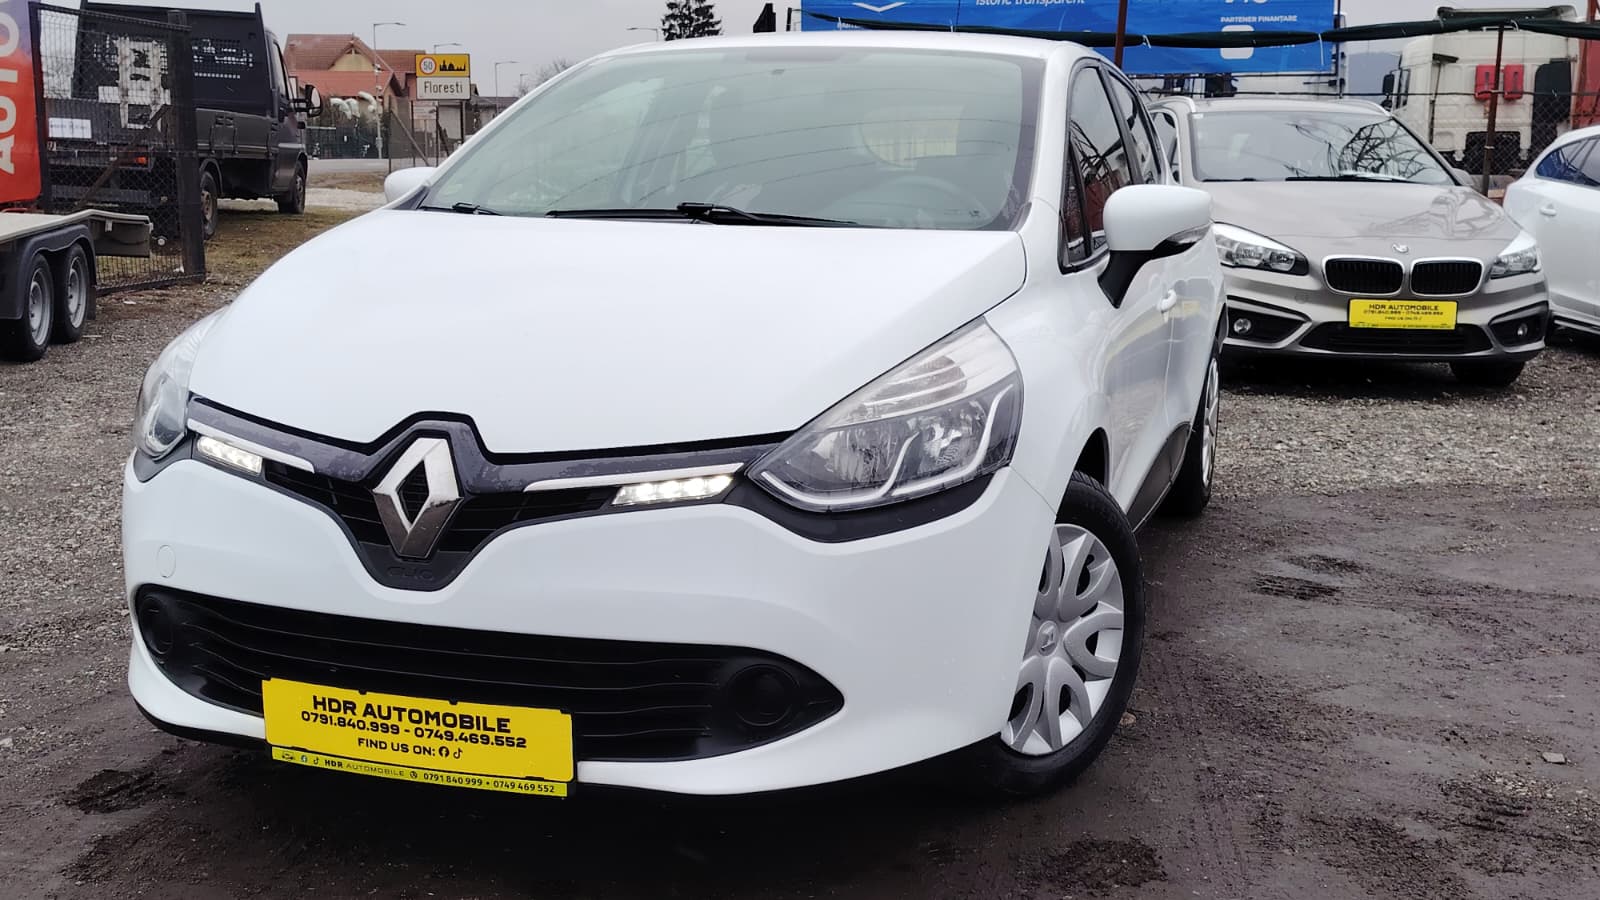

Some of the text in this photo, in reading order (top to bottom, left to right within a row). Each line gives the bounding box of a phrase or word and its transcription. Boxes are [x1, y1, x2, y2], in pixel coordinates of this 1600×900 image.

[1220, 15, 1257, 23] PARTENER
[423, 61, 433, 70] 50
[312, 695, 511, 734] HDR AUTOMOBILE
[301, 710, 400, 735] 0791.840.999
[414, 726, 527, 749] 0749.469.552
[357, 737, 436, 758] FIND US ON:
[324, 759, 344, 769] HDR
[346, 763, 404, 778] AUTOMOBILE
